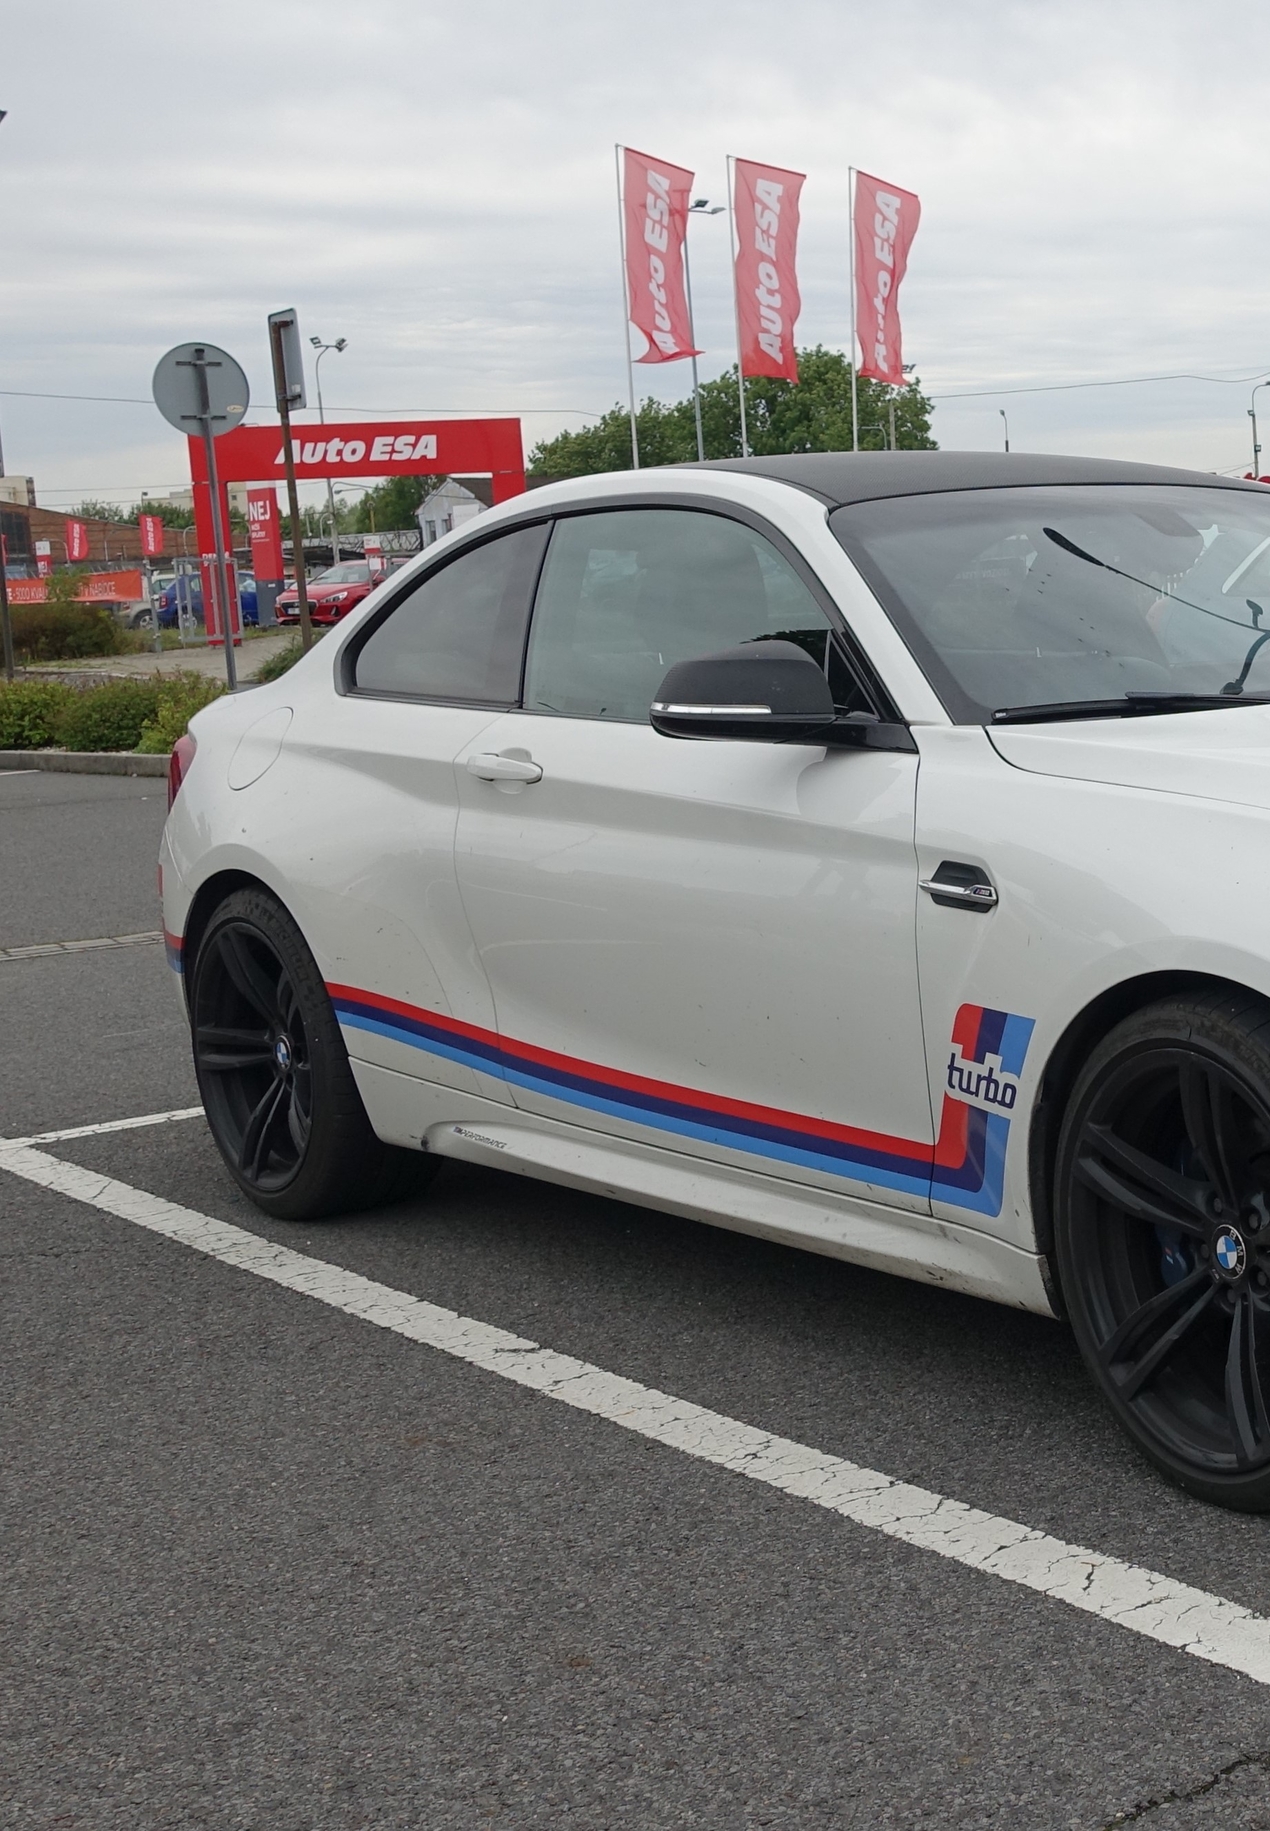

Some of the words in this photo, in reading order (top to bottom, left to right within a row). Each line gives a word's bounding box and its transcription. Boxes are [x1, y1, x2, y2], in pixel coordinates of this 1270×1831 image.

[644, 169, 671, 254] ESA
[754, 178, 784, 262] ESA
[873, 190, 901, 269] ESA
[754, 261, 784, 365] Auto
[273, 437, 366, 464] Auto
[369, 434, 438, 461] ESA
[249, 500, 271, 521] NEJ
[947, 1052, 1017, 1110] turbo
